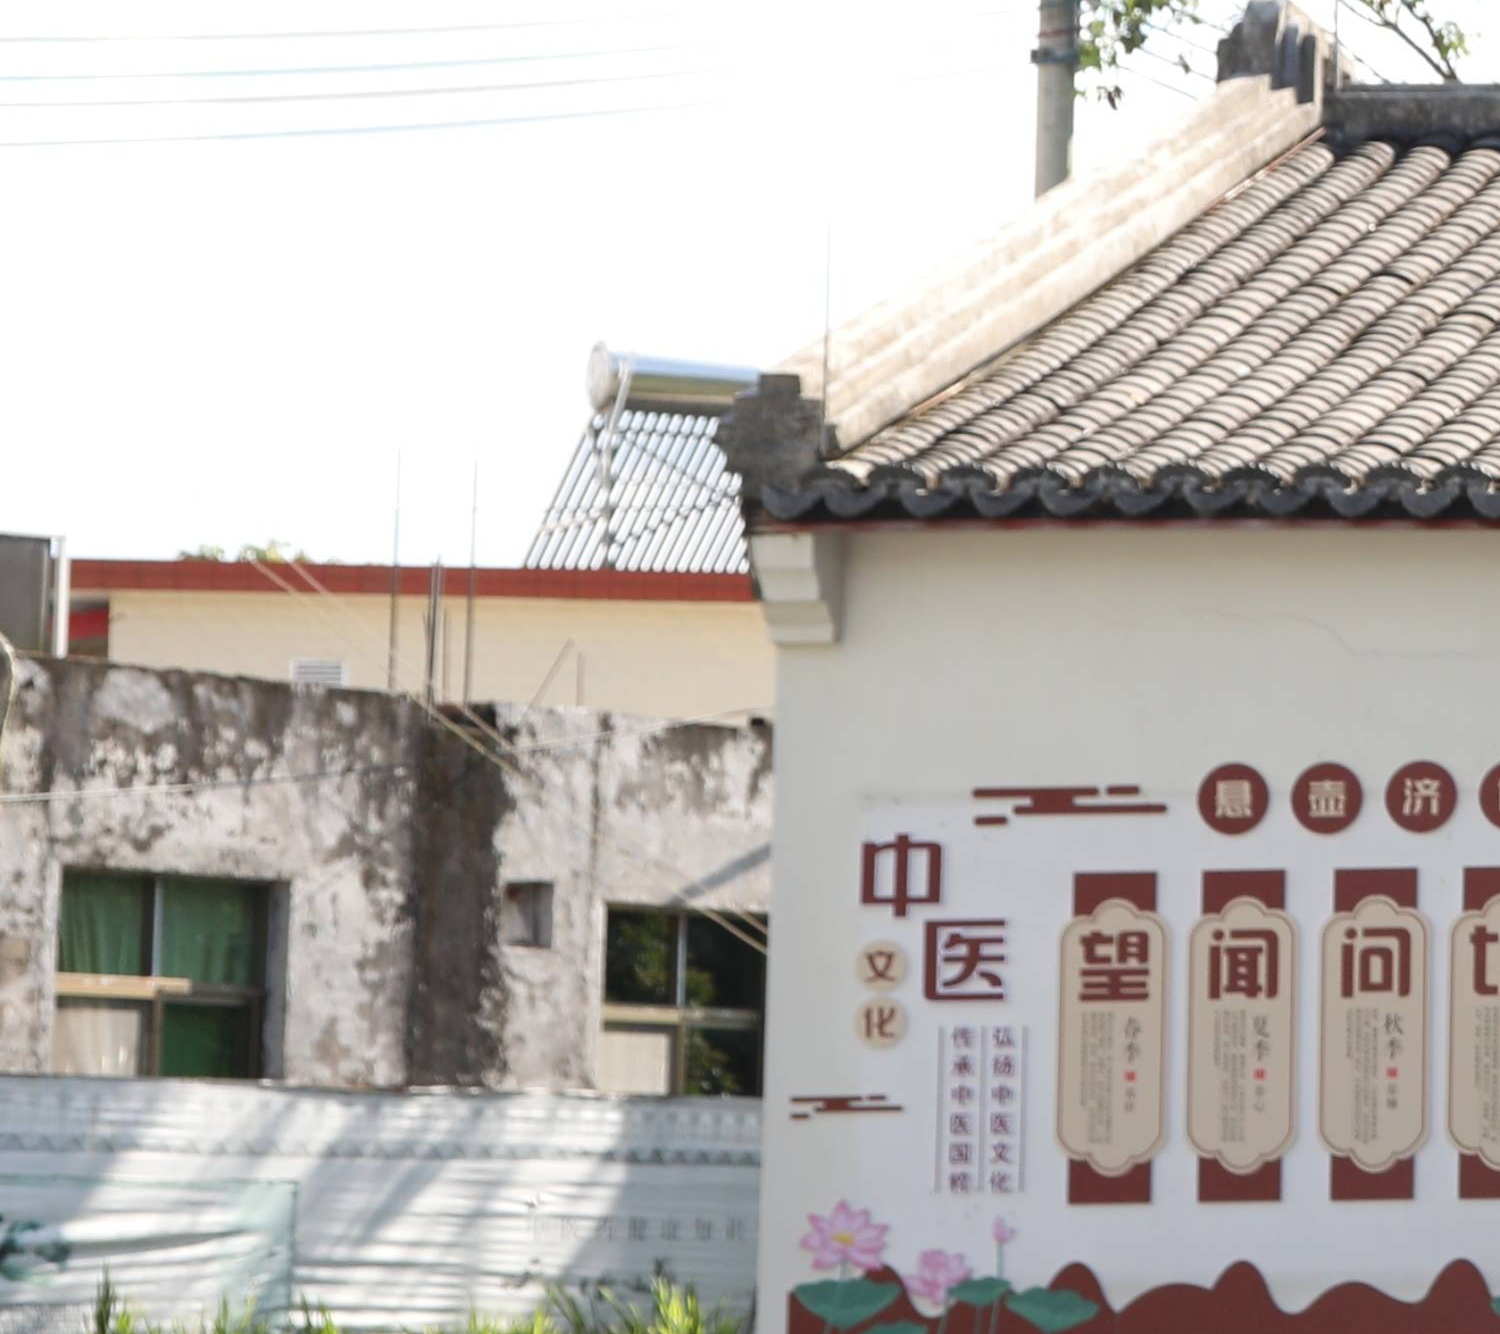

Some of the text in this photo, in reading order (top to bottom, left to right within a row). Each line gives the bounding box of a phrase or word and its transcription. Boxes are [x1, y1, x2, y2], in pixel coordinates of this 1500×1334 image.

[864, 950, 897, 1040] 文化
[949, 1027, 974, 1194] 传承中医国粹
[990, 1027, 1015, 1194] 弘扬中医文化
